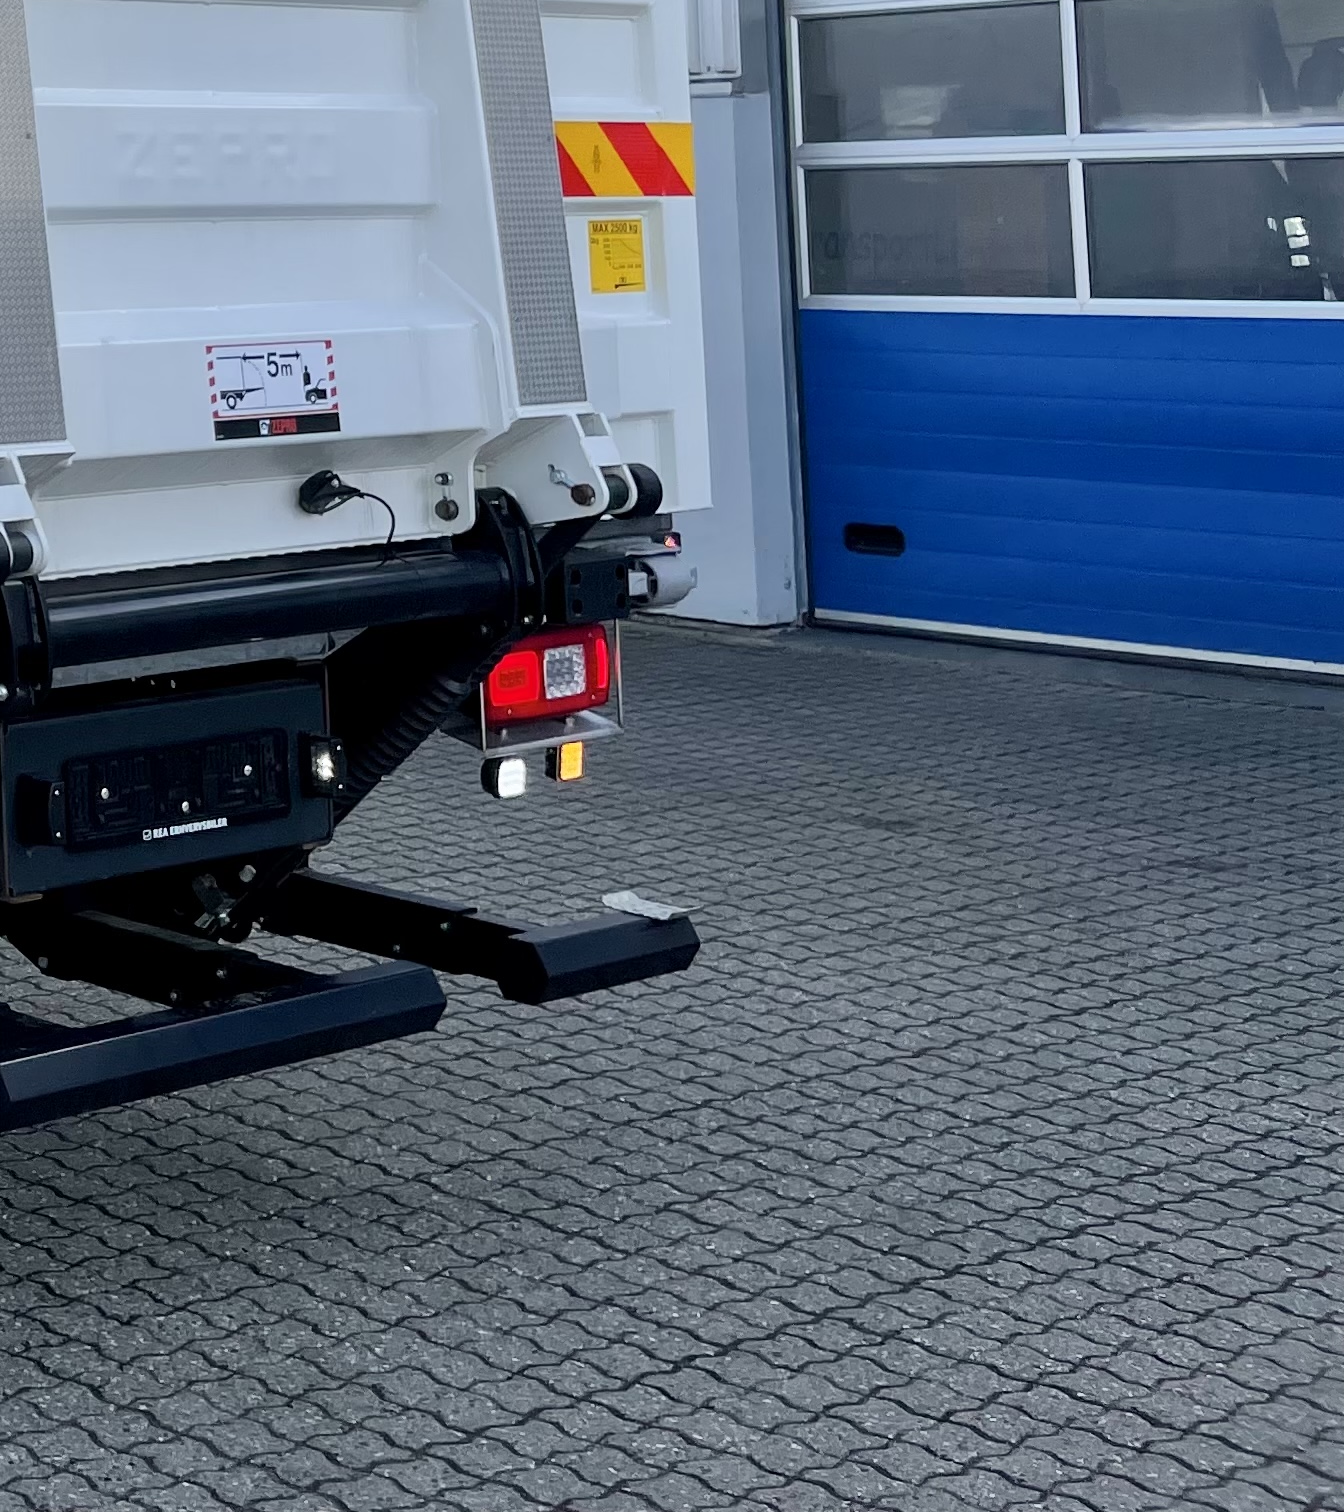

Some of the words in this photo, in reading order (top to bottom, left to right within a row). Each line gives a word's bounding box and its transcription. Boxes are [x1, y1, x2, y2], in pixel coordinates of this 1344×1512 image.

[592, 223, 609, 233] MAX
[629, 223, 638, 234] kg
[272, 418, 297, 434] ZEPRO
[153, 828, 168, 839] REA
